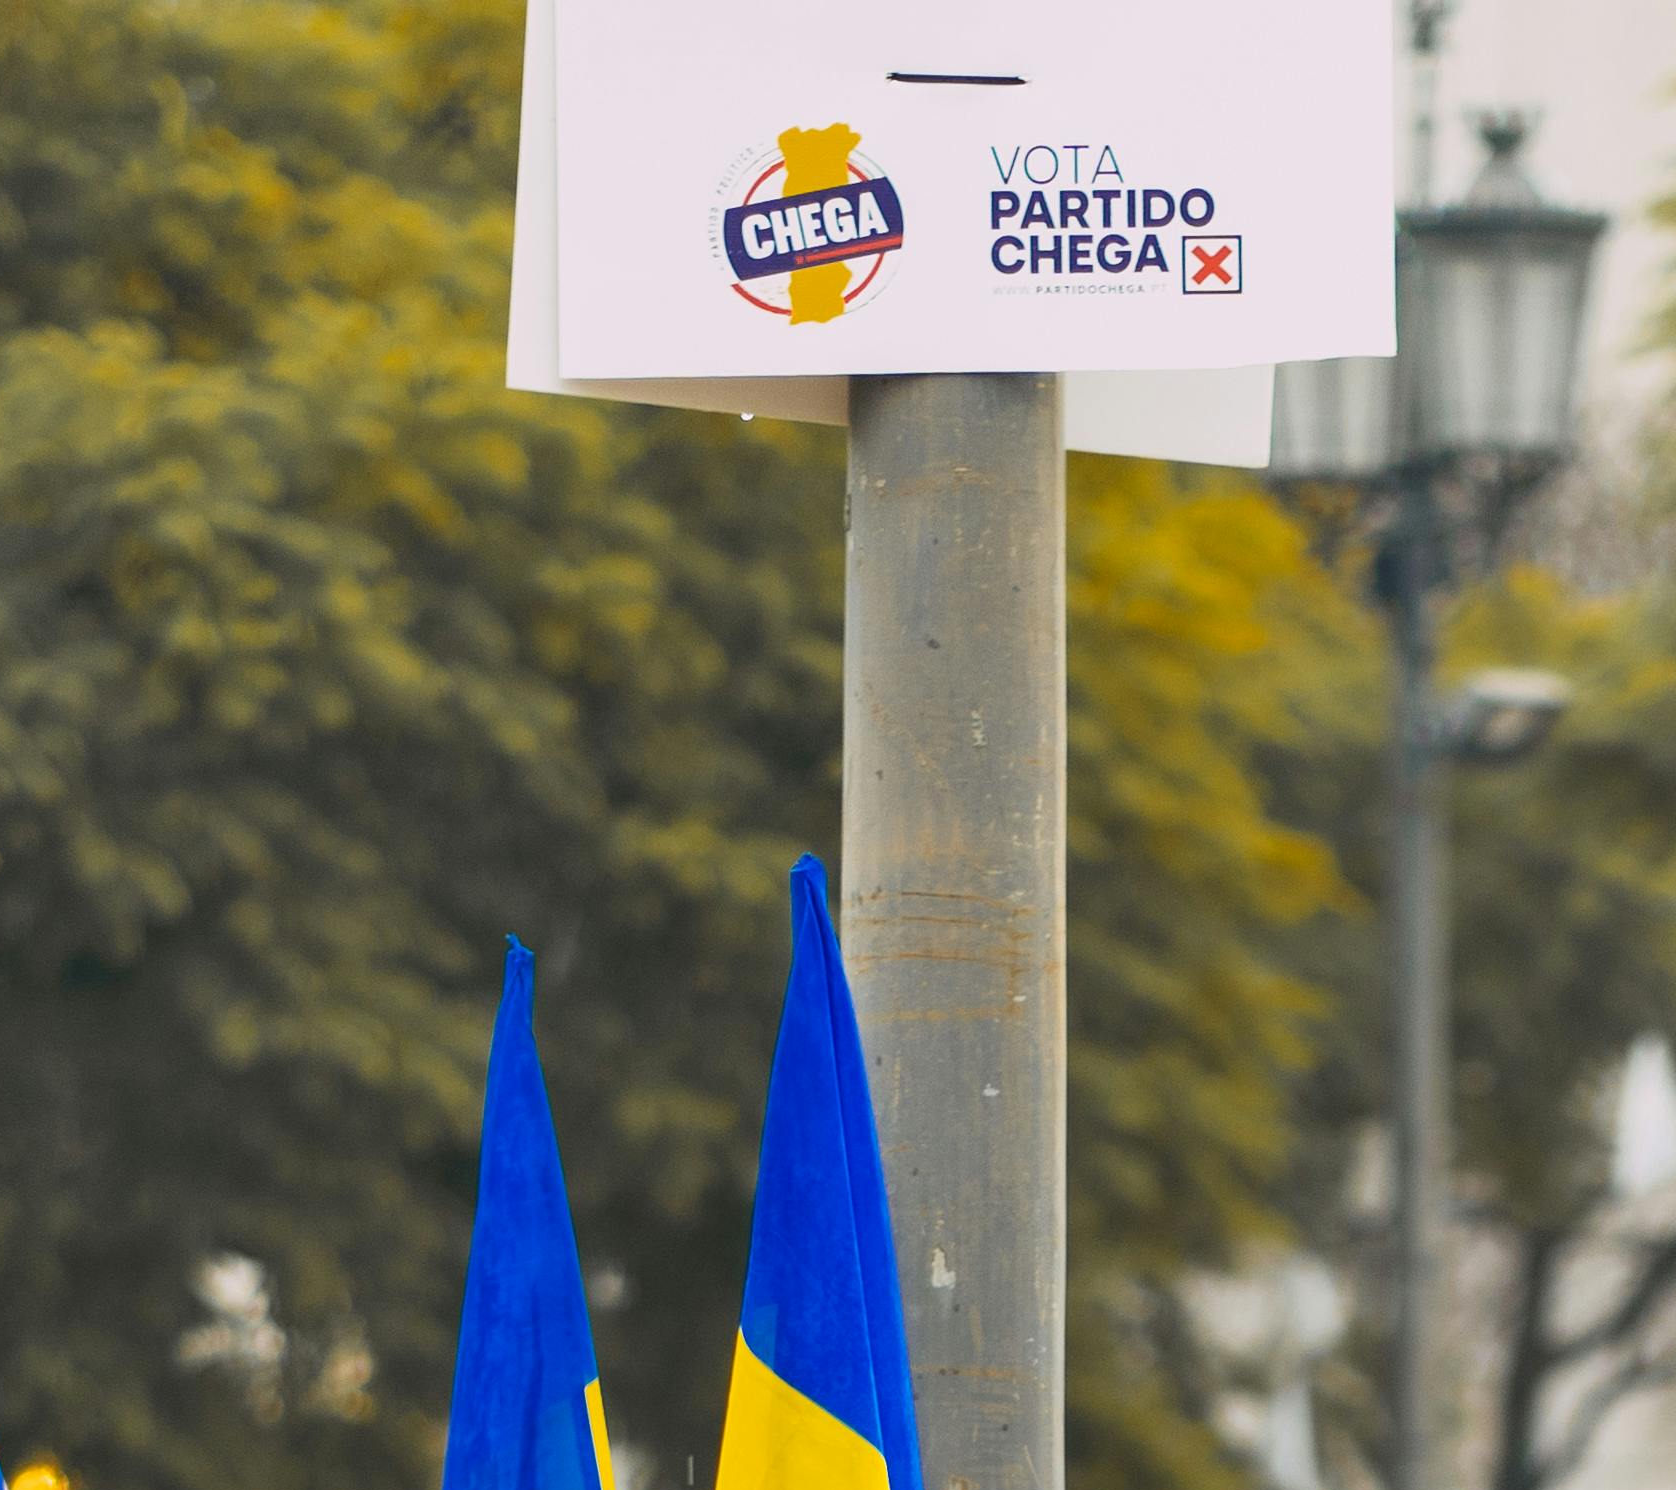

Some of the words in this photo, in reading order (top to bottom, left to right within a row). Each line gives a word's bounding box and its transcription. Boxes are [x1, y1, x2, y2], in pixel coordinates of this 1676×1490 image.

[990, 144, 1124, 185] VOTA
[741, 191, 890, 260] CHEGA
[990, 187, 1215, 230] PARTIDO
[990, 233, 1170, 274] CHEGA
